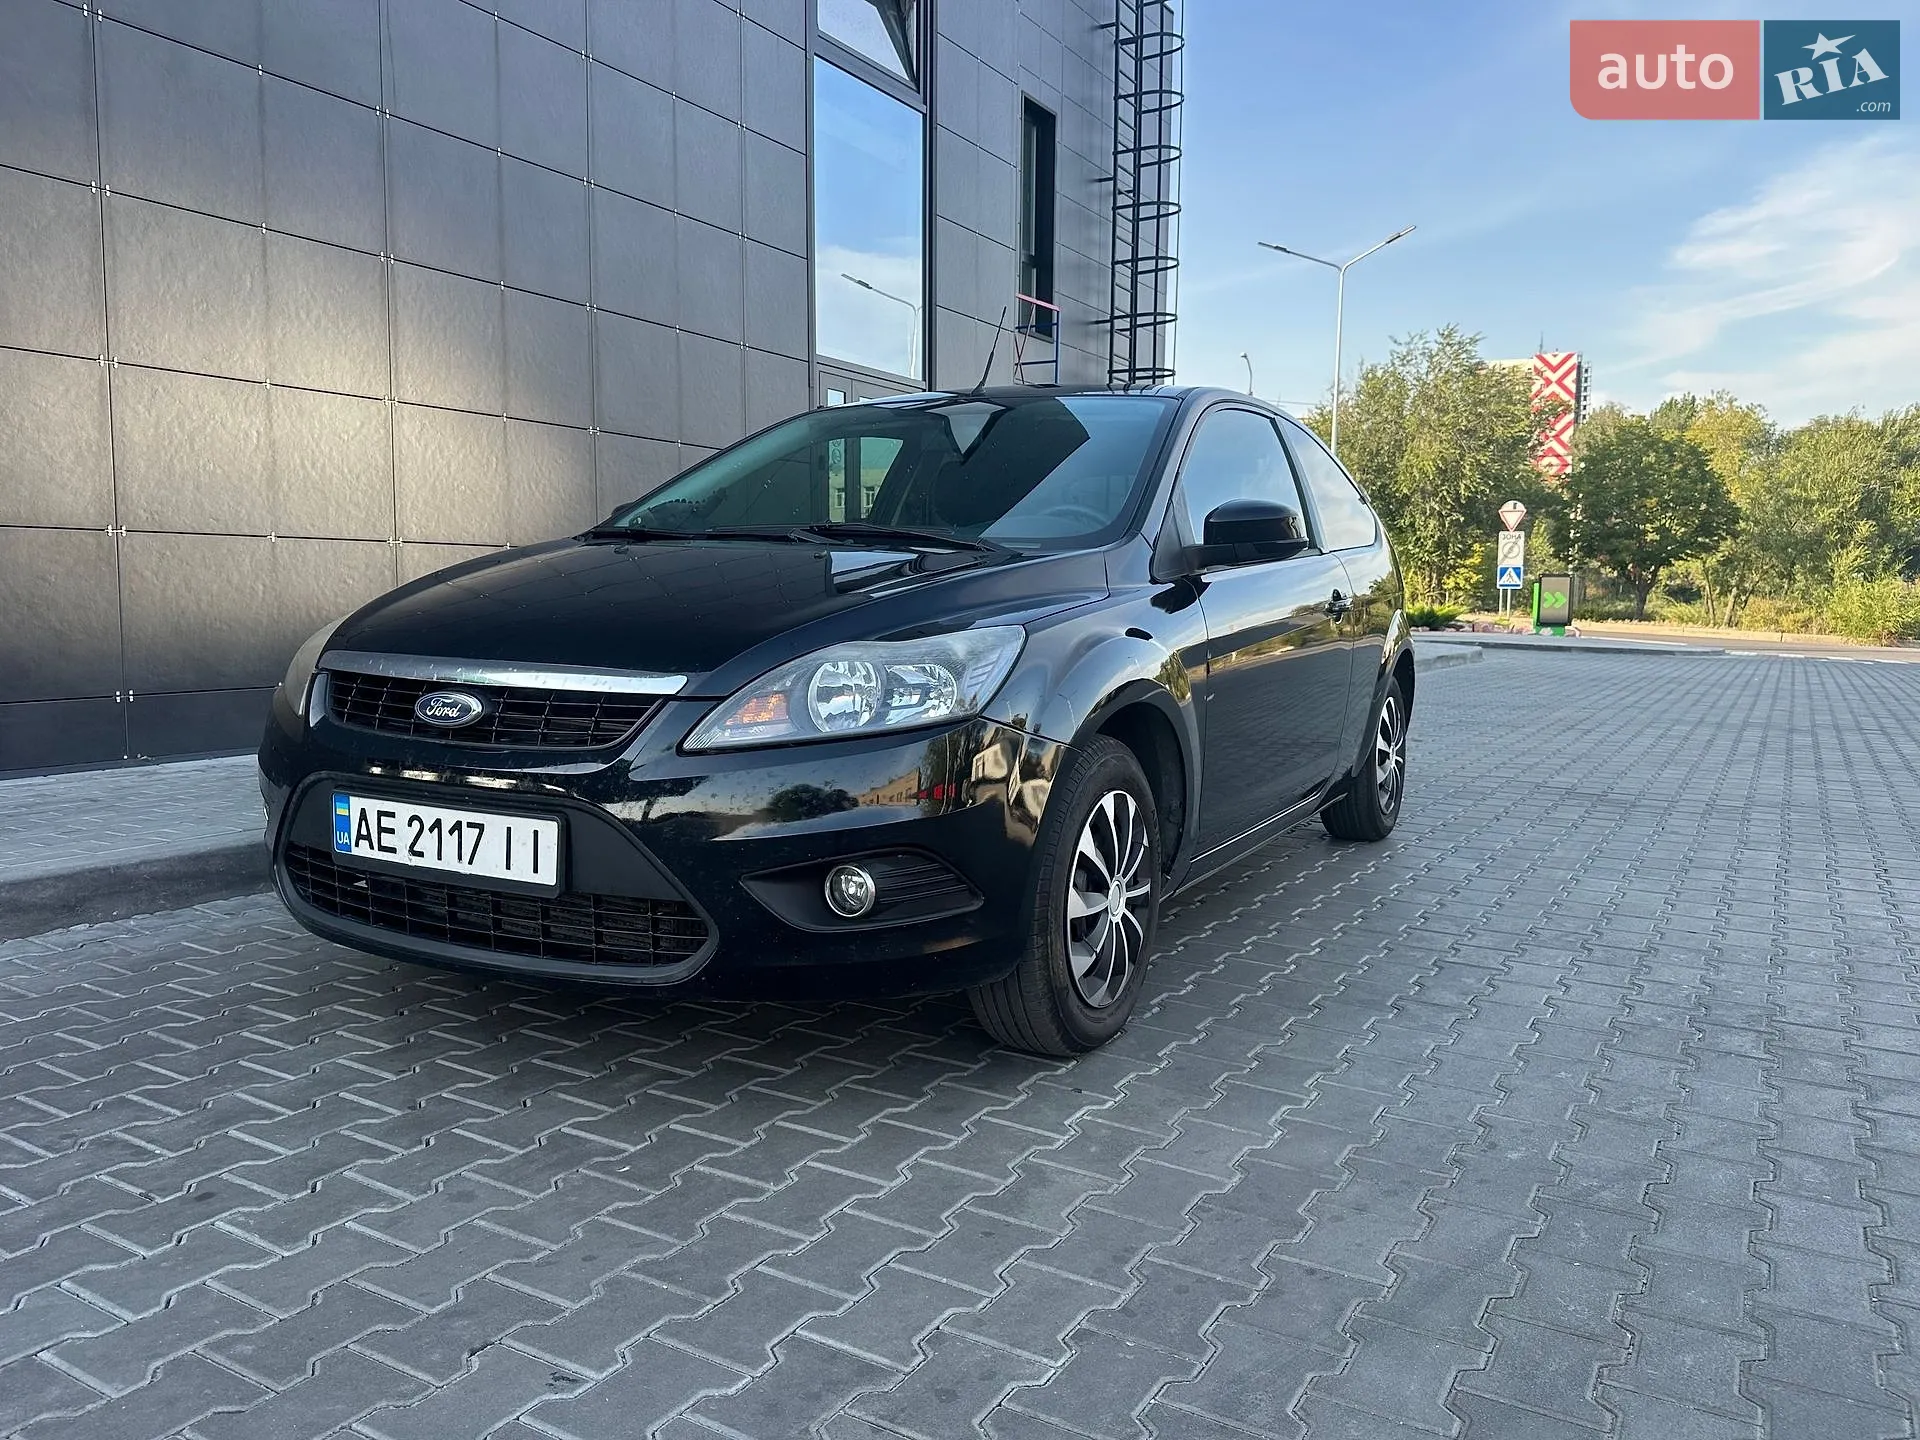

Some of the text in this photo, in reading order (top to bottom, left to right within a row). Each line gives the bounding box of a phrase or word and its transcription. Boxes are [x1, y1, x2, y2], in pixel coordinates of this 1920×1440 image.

[426, 697, 462, 718] Ford
[336, 830, 350, 846] UA
[354, 807, 397, 854] AE
[407, 814, 485, 865] 2117
